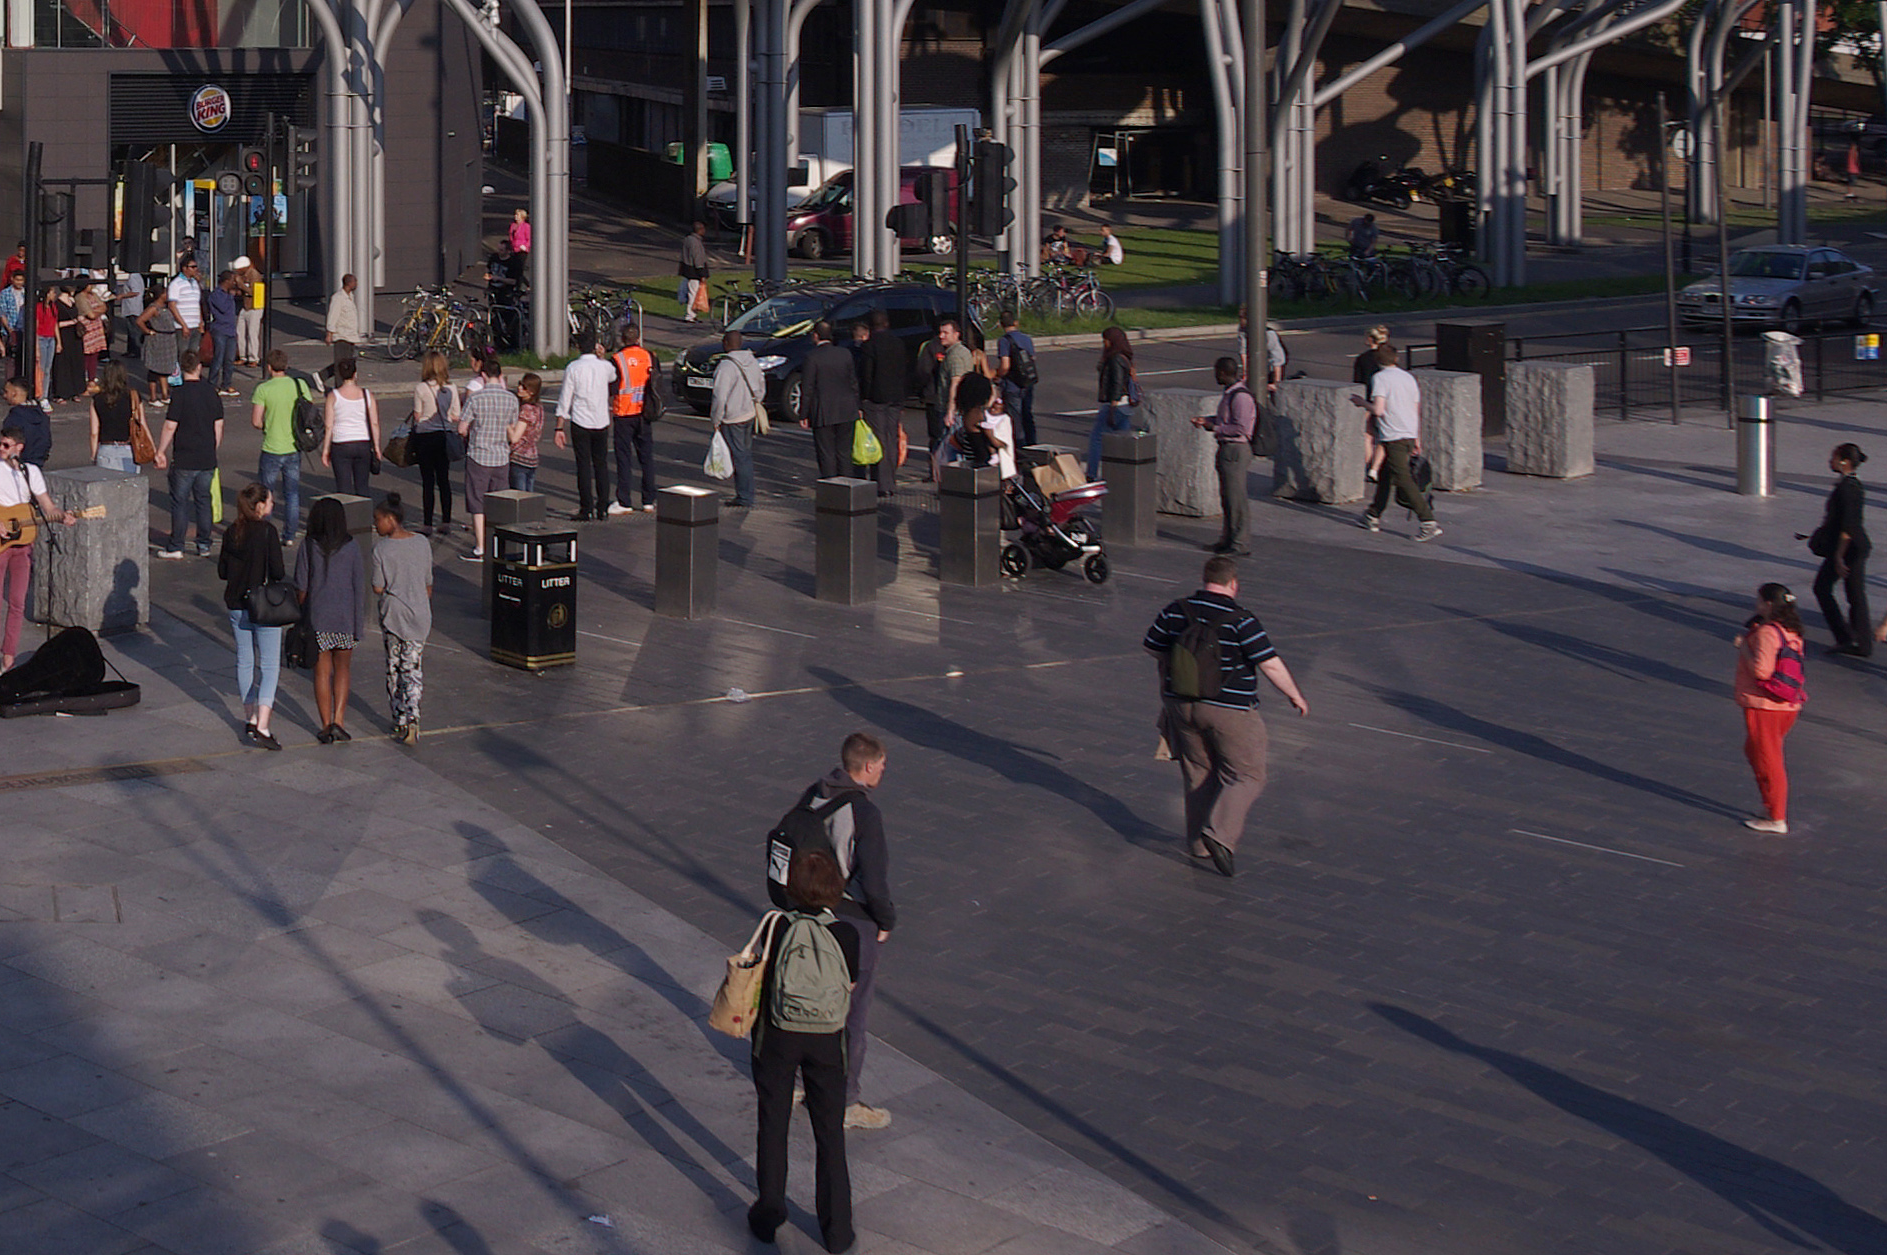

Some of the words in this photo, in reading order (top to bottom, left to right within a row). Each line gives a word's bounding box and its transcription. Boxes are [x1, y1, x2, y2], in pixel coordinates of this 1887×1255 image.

[196, 95, 225, 110] BURGER
[196, 104, 225, 122] KING
[498, 573, 523, 587] LITTER
[541, 576, 570, 589] LITTER
